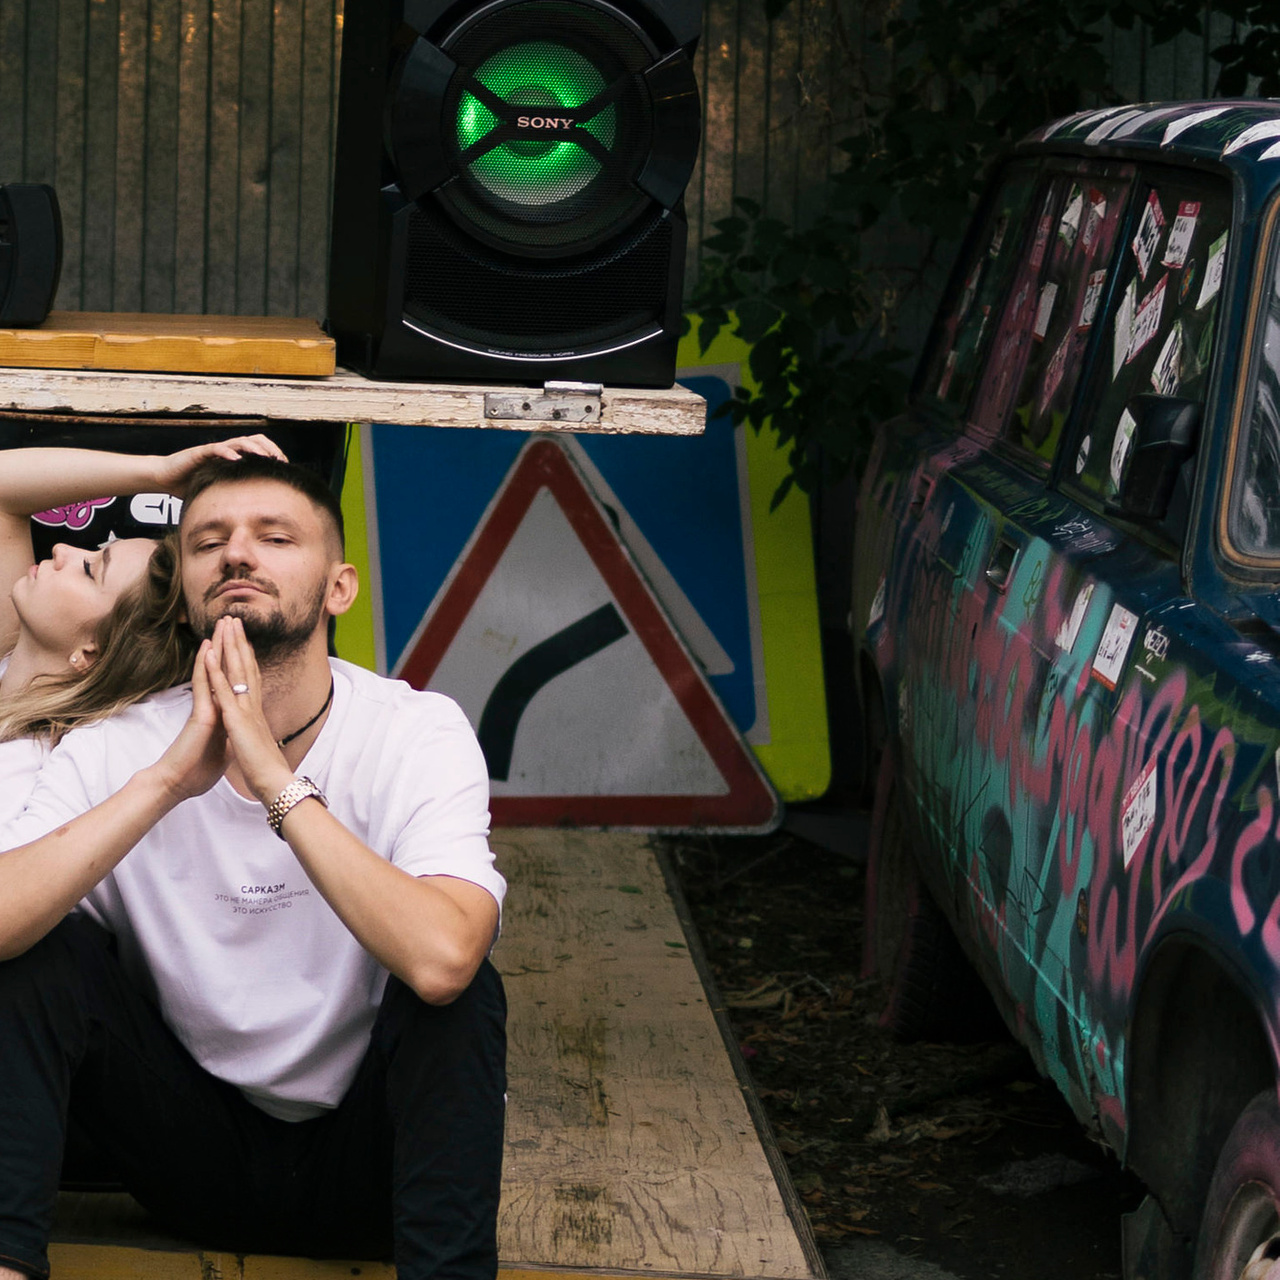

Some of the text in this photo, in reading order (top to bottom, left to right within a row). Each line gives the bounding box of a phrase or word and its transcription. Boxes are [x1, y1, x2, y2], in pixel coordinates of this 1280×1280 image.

[517, 116, 574, 130] SONY
[241, 883, 286, 894] САРКАЗМ
[214, 889, 310, 905] ЭТО НЕ МАНЕРА ОБЩЕНИЯ
[233, 901, 293, 915] ЭТО ИСКУССТВО
